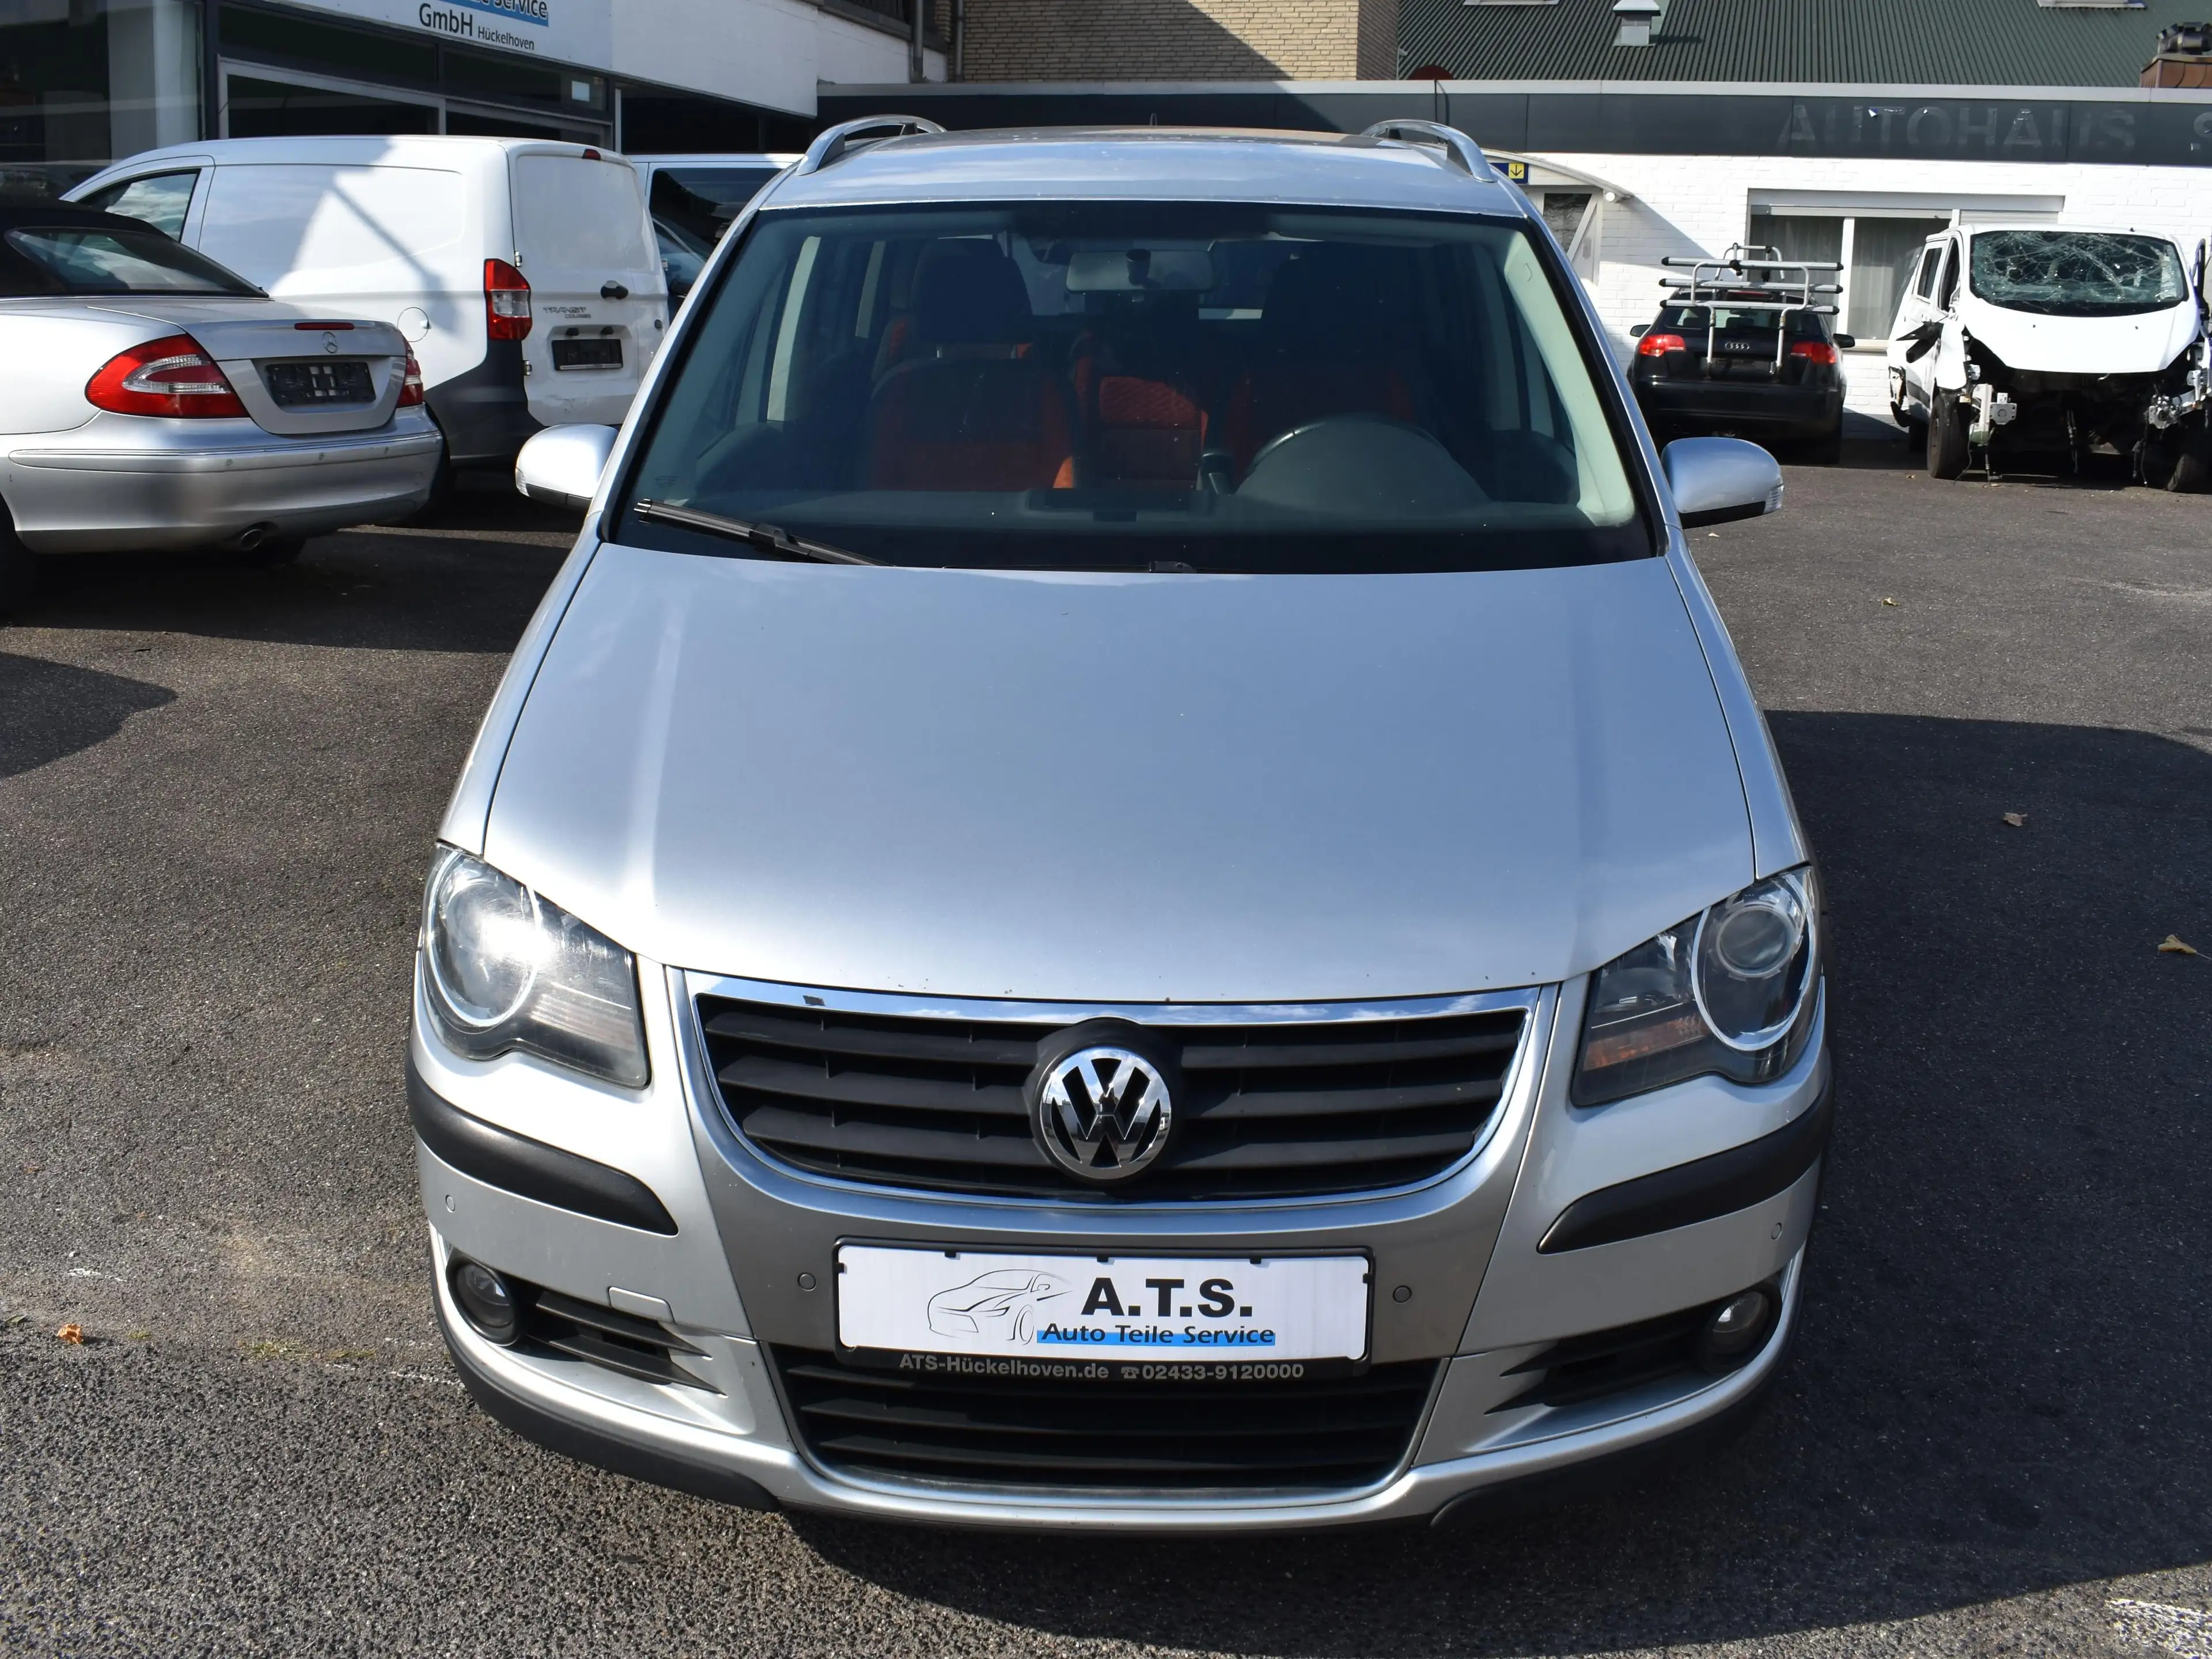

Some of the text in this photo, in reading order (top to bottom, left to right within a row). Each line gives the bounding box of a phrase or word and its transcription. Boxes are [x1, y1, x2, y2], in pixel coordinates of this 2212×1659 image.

[419, 3, 535, 51] GmbH Hückelhoven
[1081, 1277, 1252, 1318] A.T.S.
[1041, 1323, 1275, 1344] Auto Teile Service
[899, 1353, 1304, 1380] ATS-Hückelhoven.de 02433-9120000
